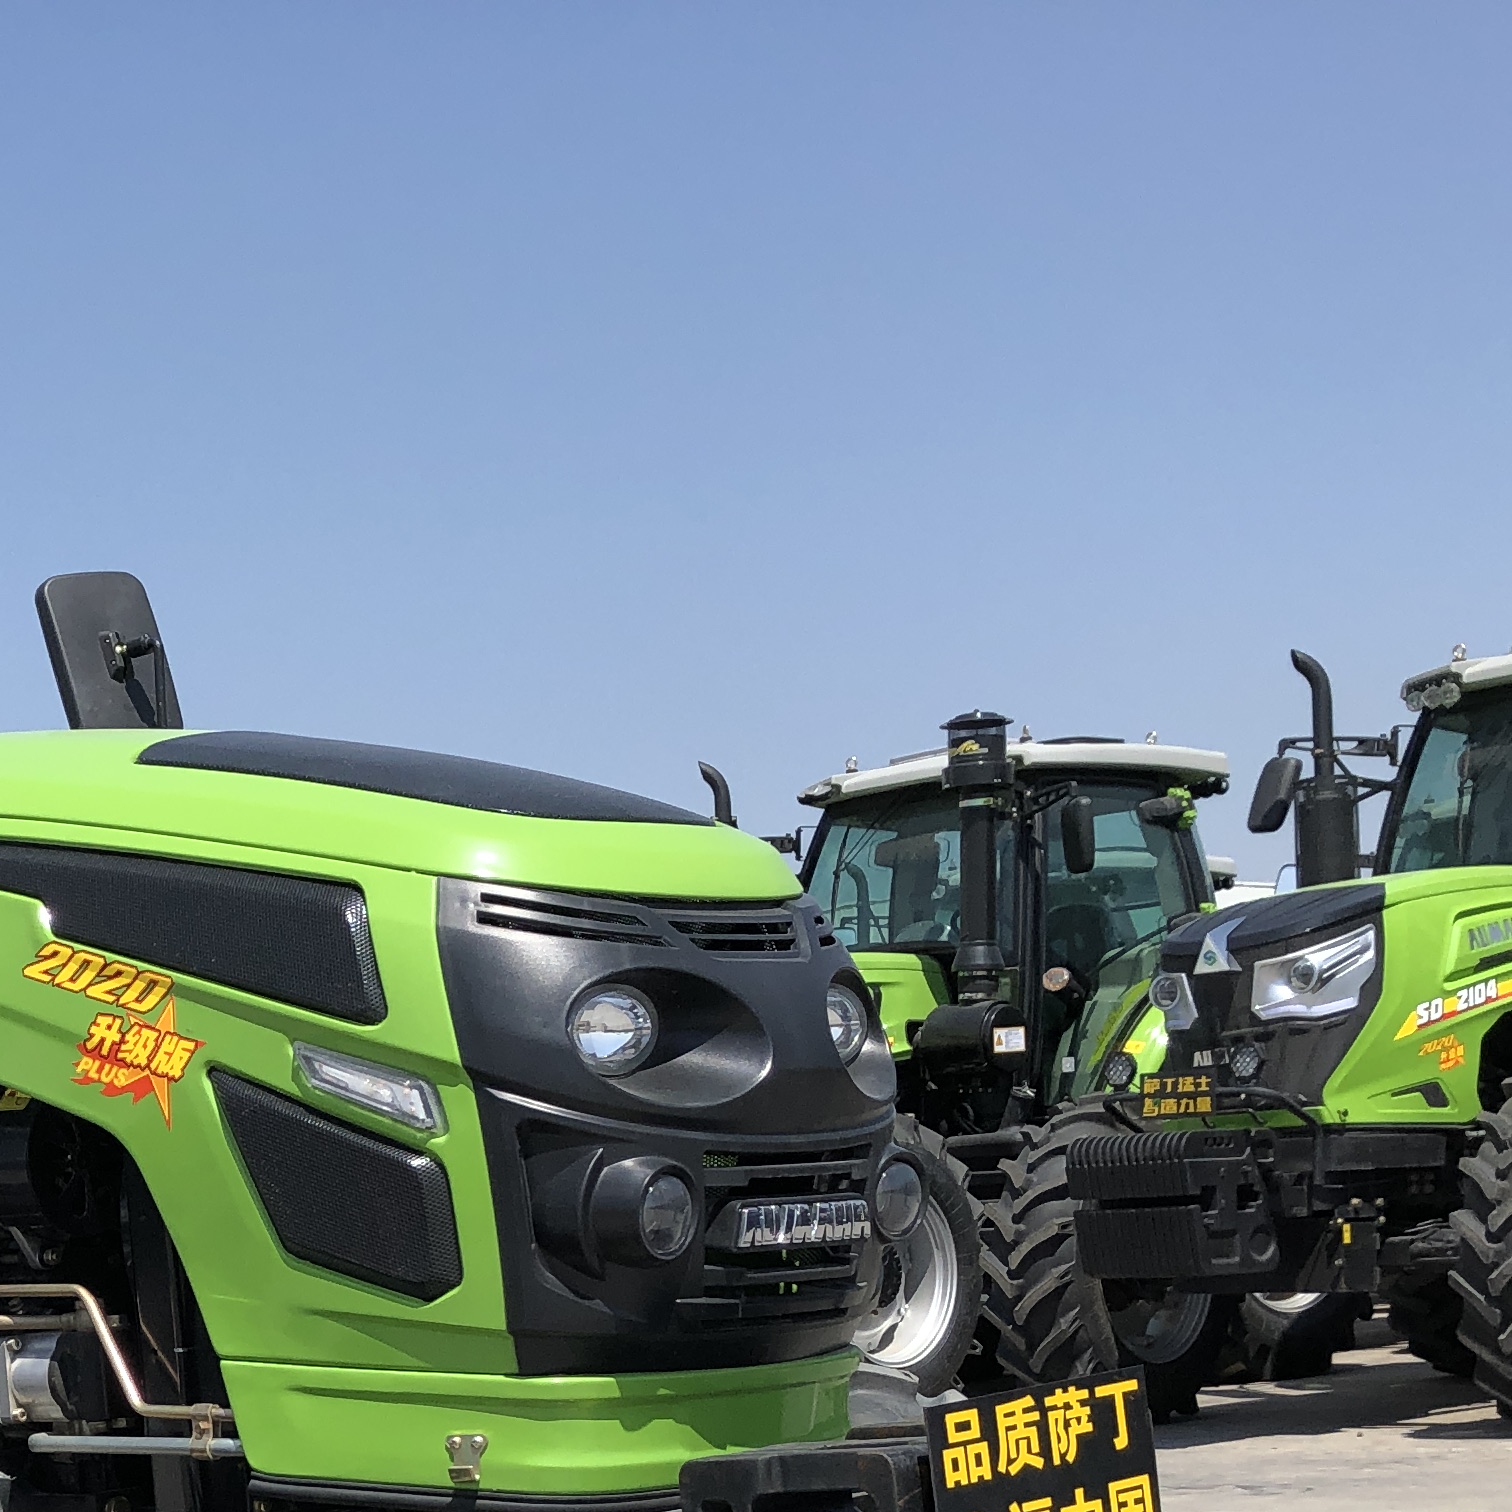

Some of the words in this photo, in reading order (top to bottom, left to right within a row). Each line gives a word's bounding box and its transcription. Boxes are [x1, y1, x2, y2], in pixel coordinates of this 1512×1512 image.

[22, 940, 175, 1015] 2020
[1457, 978, 1498, 1012] 2104
[76, 1057, 128, 1088] PLUS
[83, 1012, 200, 1082] 升级版
[942, 1379, 1139, 1489] 品质萨丁
